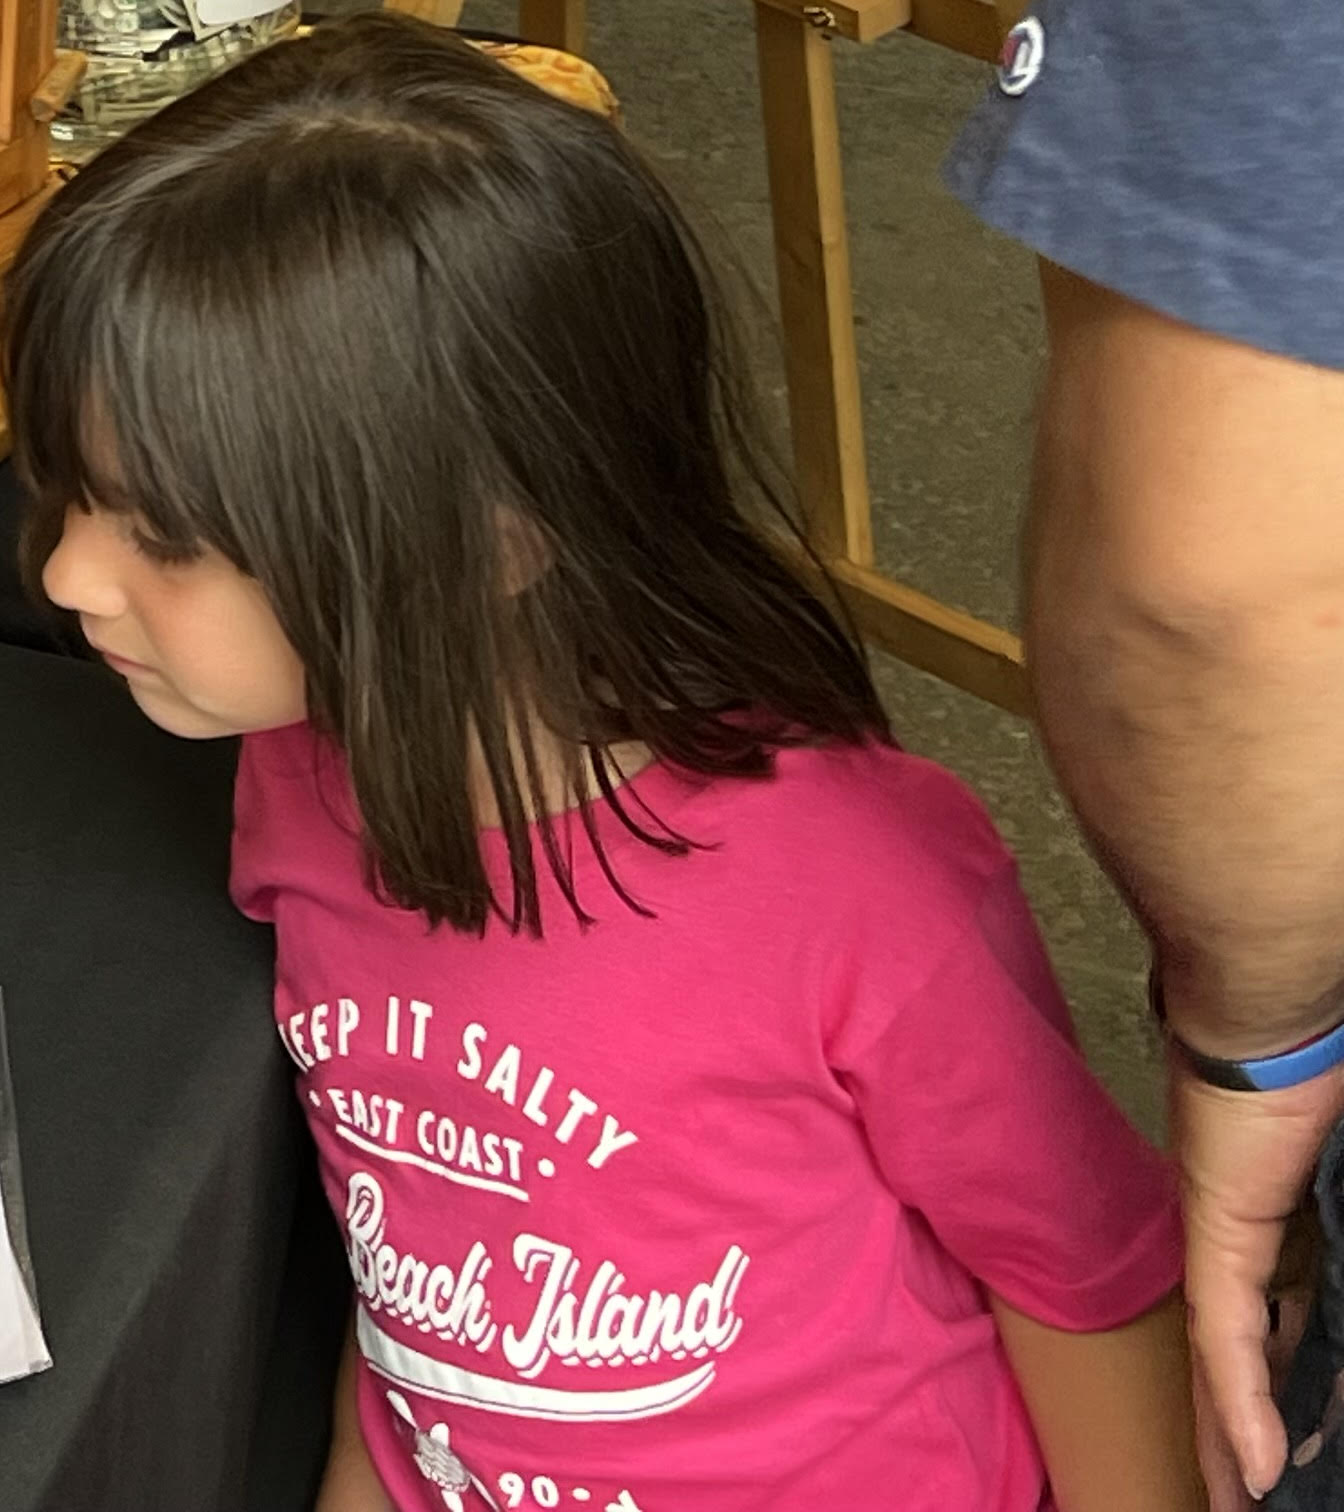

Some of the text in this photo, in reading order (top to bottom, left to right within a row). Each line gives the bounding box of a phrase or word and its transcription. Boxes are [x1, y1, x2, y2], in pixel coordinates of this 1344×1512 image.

[327, 1088, 524, 1181] EAST COAST
[386, 996, 433, 1060] IT
[457, 1022, 639, 1169] SALTY
[346, 1172, 750, 1379] Beach Island
